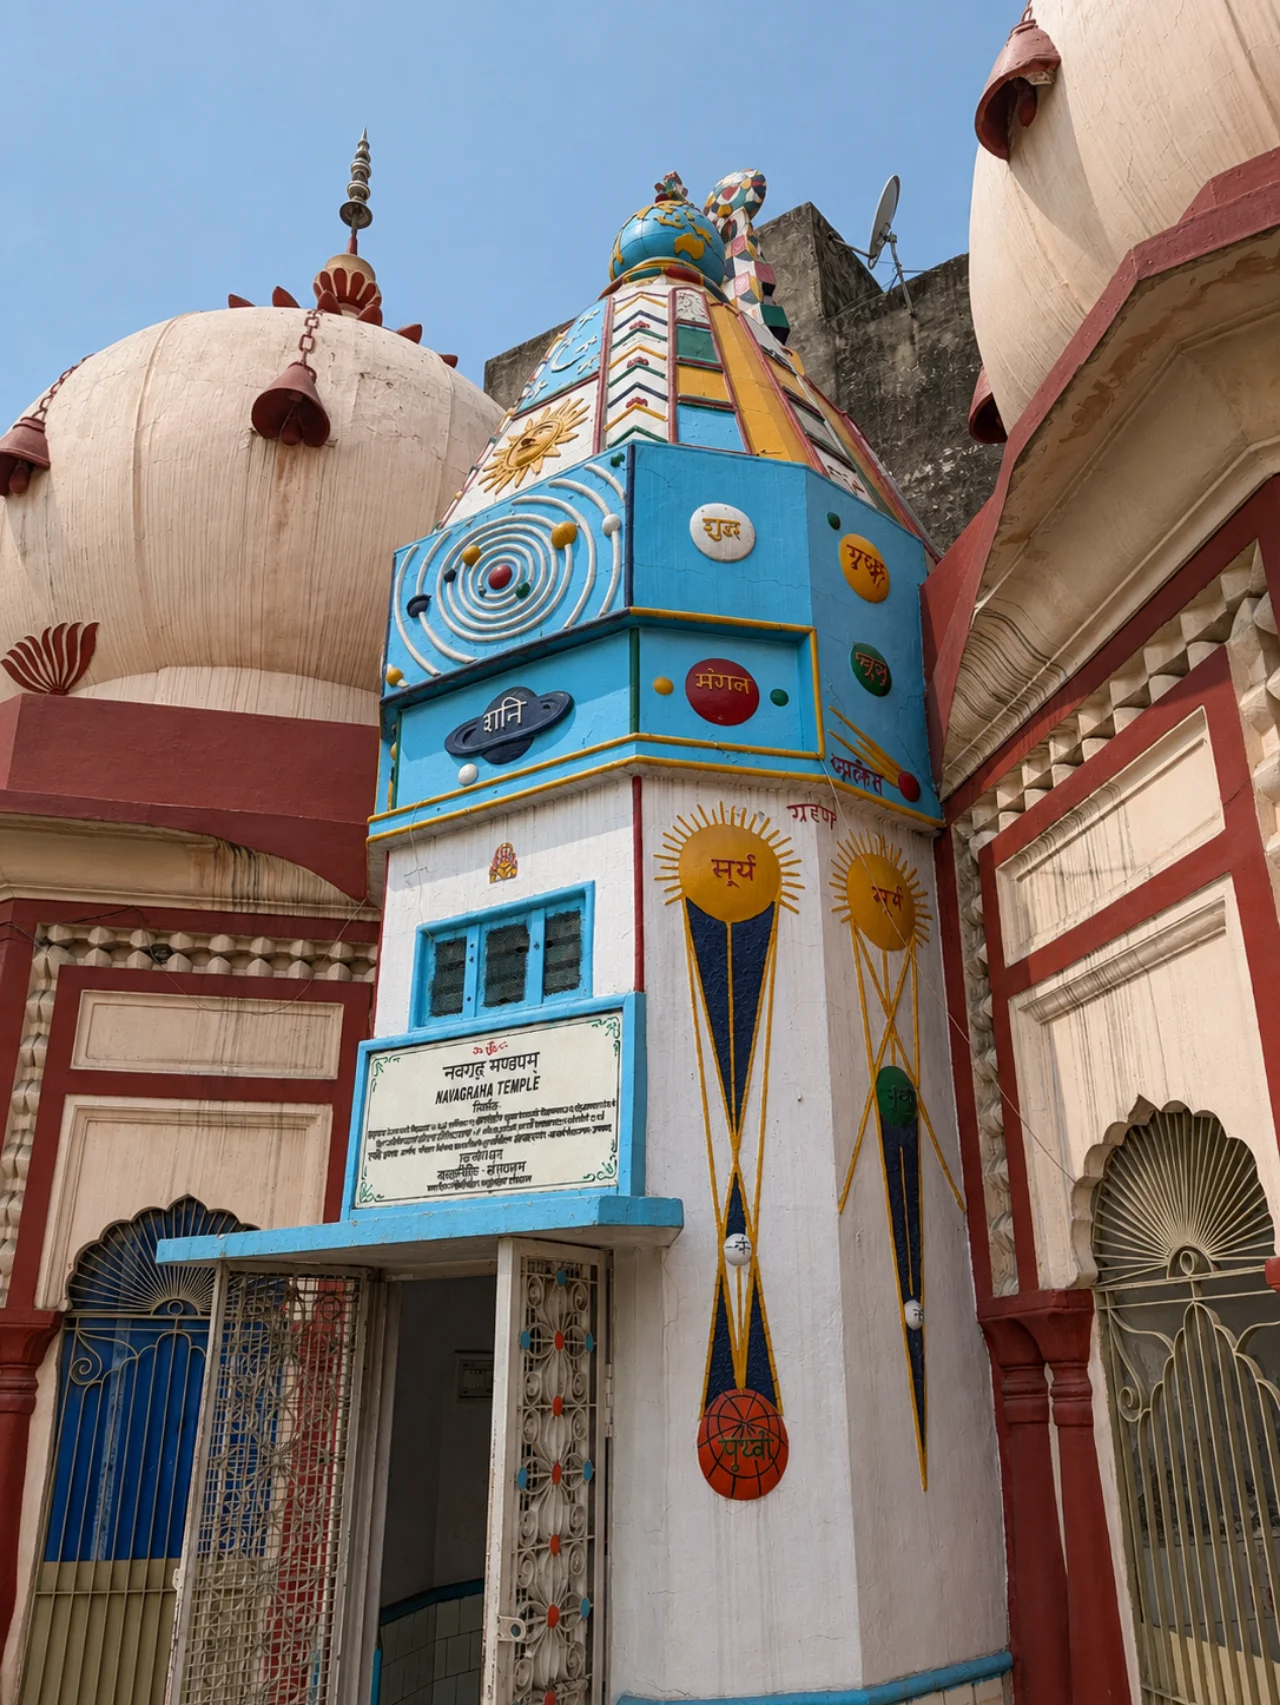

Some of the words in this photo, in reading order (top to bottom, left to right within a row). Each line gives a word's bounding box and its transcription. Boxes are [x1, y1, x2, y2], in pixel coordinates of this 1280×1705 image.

[483, 696, 527, 732] शनि
[711, 854, 757, 888] सूर्य
[435, 1082, 494, 1105] NAVAGRAHA
[497, 1075, 541, 1096] TEMPLE
